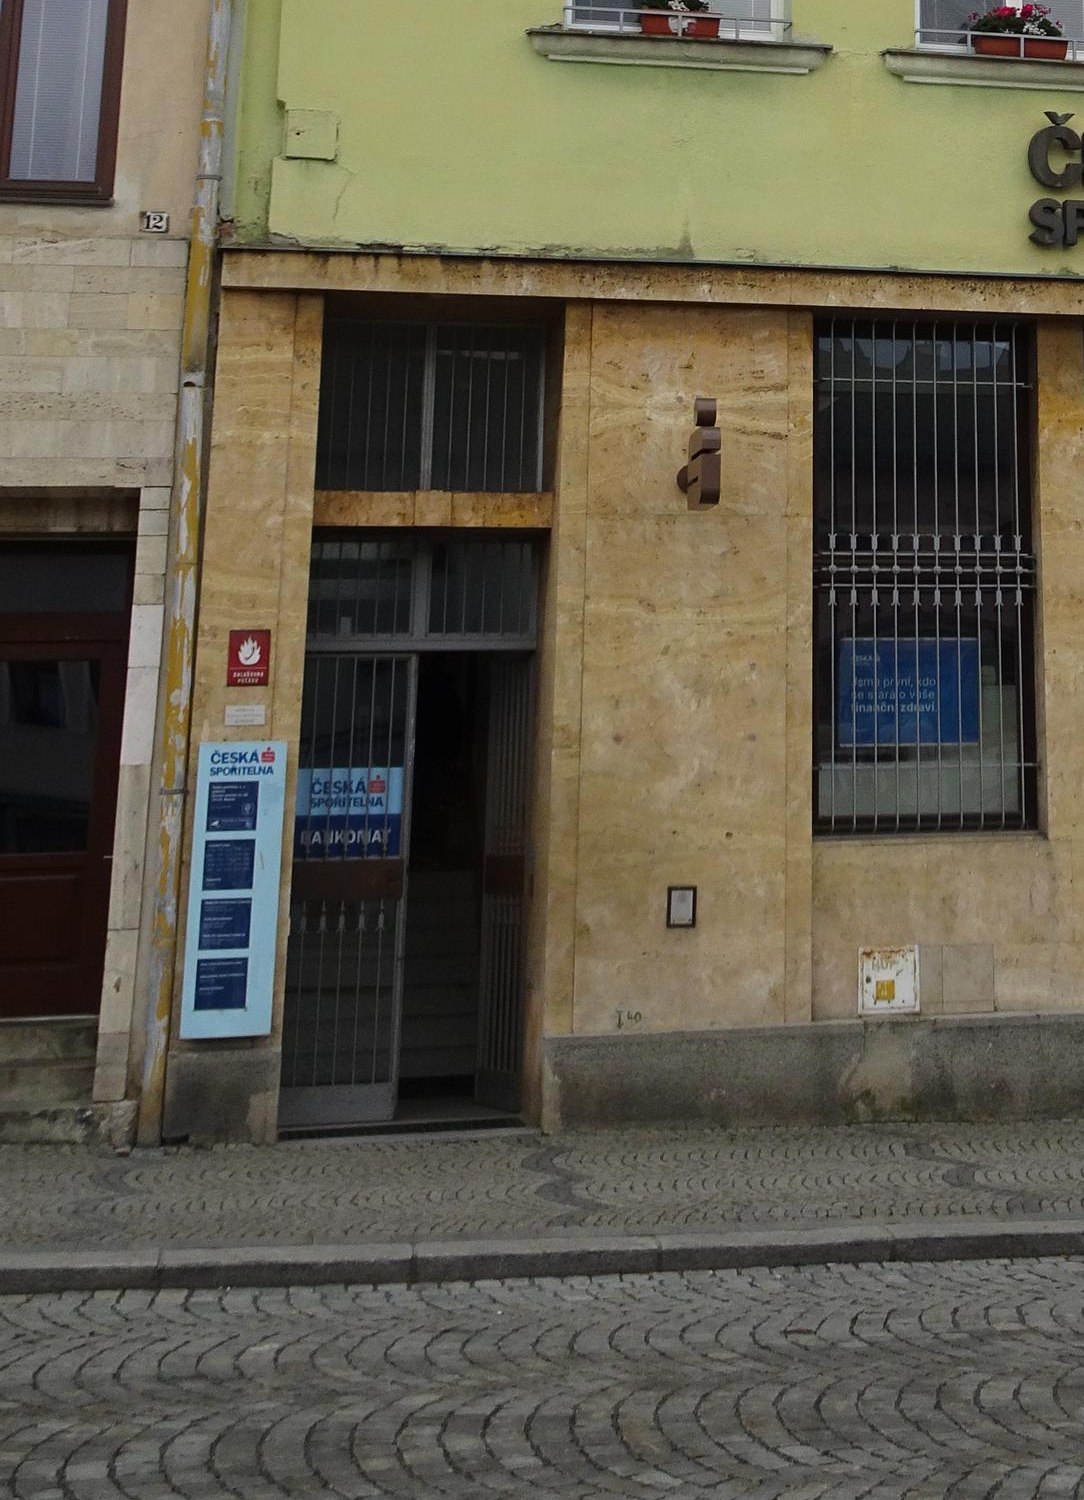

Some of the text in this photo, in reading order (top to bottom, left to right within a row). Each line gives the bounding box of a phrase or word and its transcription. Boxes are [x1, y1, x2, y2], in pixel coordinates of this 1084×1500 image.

[144, 214, 163, 230] 12
[210, 749, 259, 765] ČESKÁ
[210, 765, 274, 776] SPOŘITELNA
[311, 777, 366, 795] ČESKÁ
